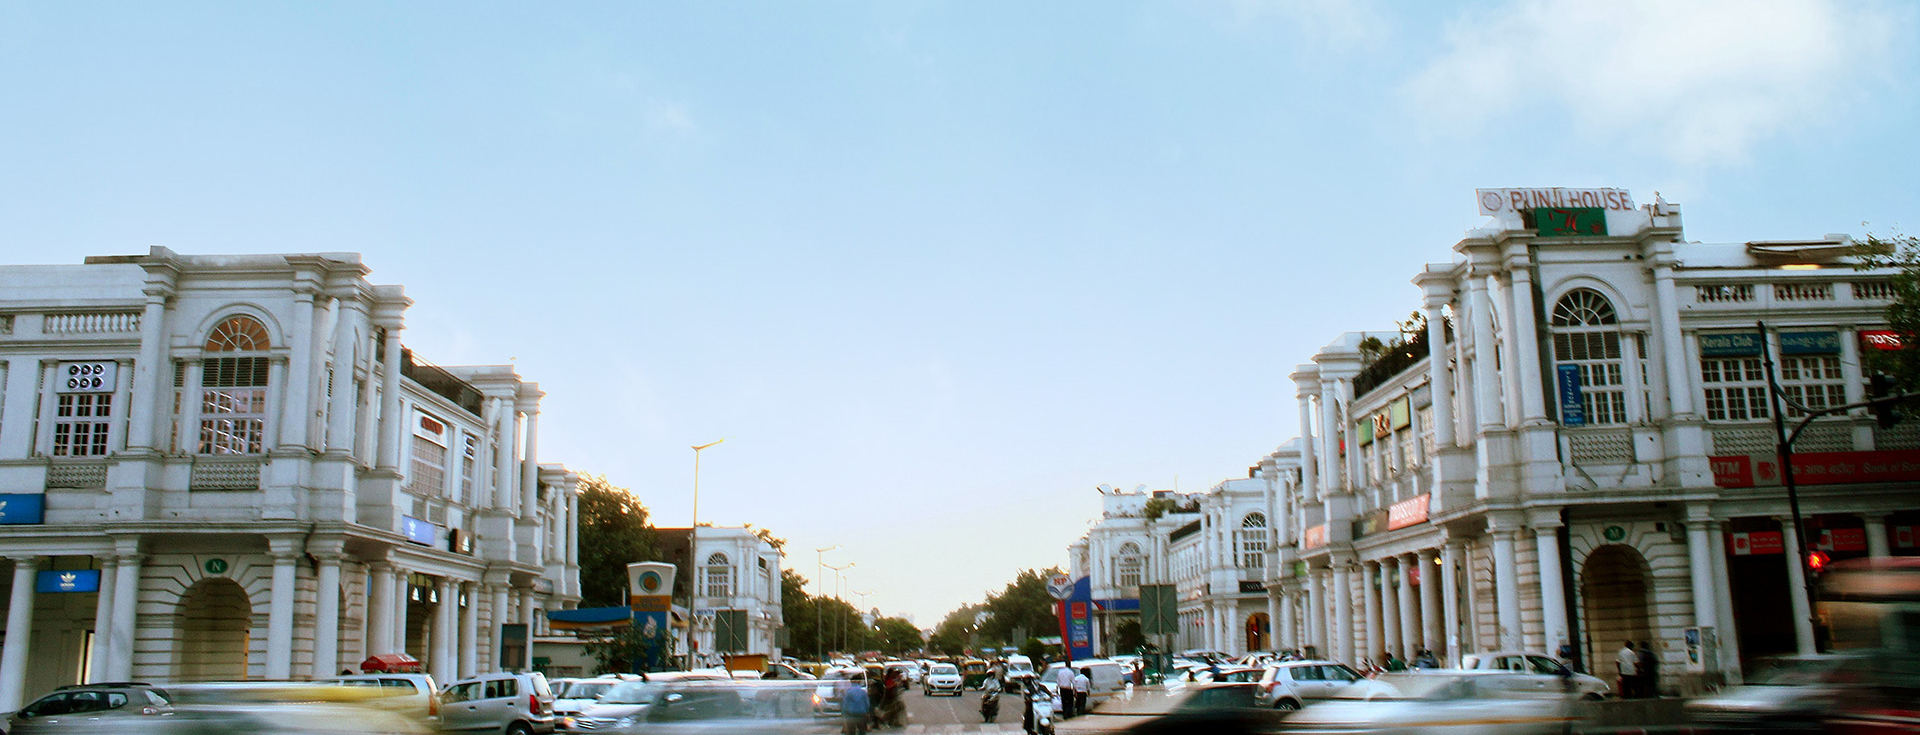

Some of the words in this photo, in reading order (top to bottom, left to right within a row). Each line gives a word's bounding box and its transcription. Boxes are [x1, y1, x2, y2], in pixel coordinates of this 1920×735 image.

[1510, 190, 1564, 210] PUNJ
[1568, 190, 1631, 210] HOUSE
[1701, 336, 1731, 348] Kerala
[1711, 461, 1740, 474] ATM
